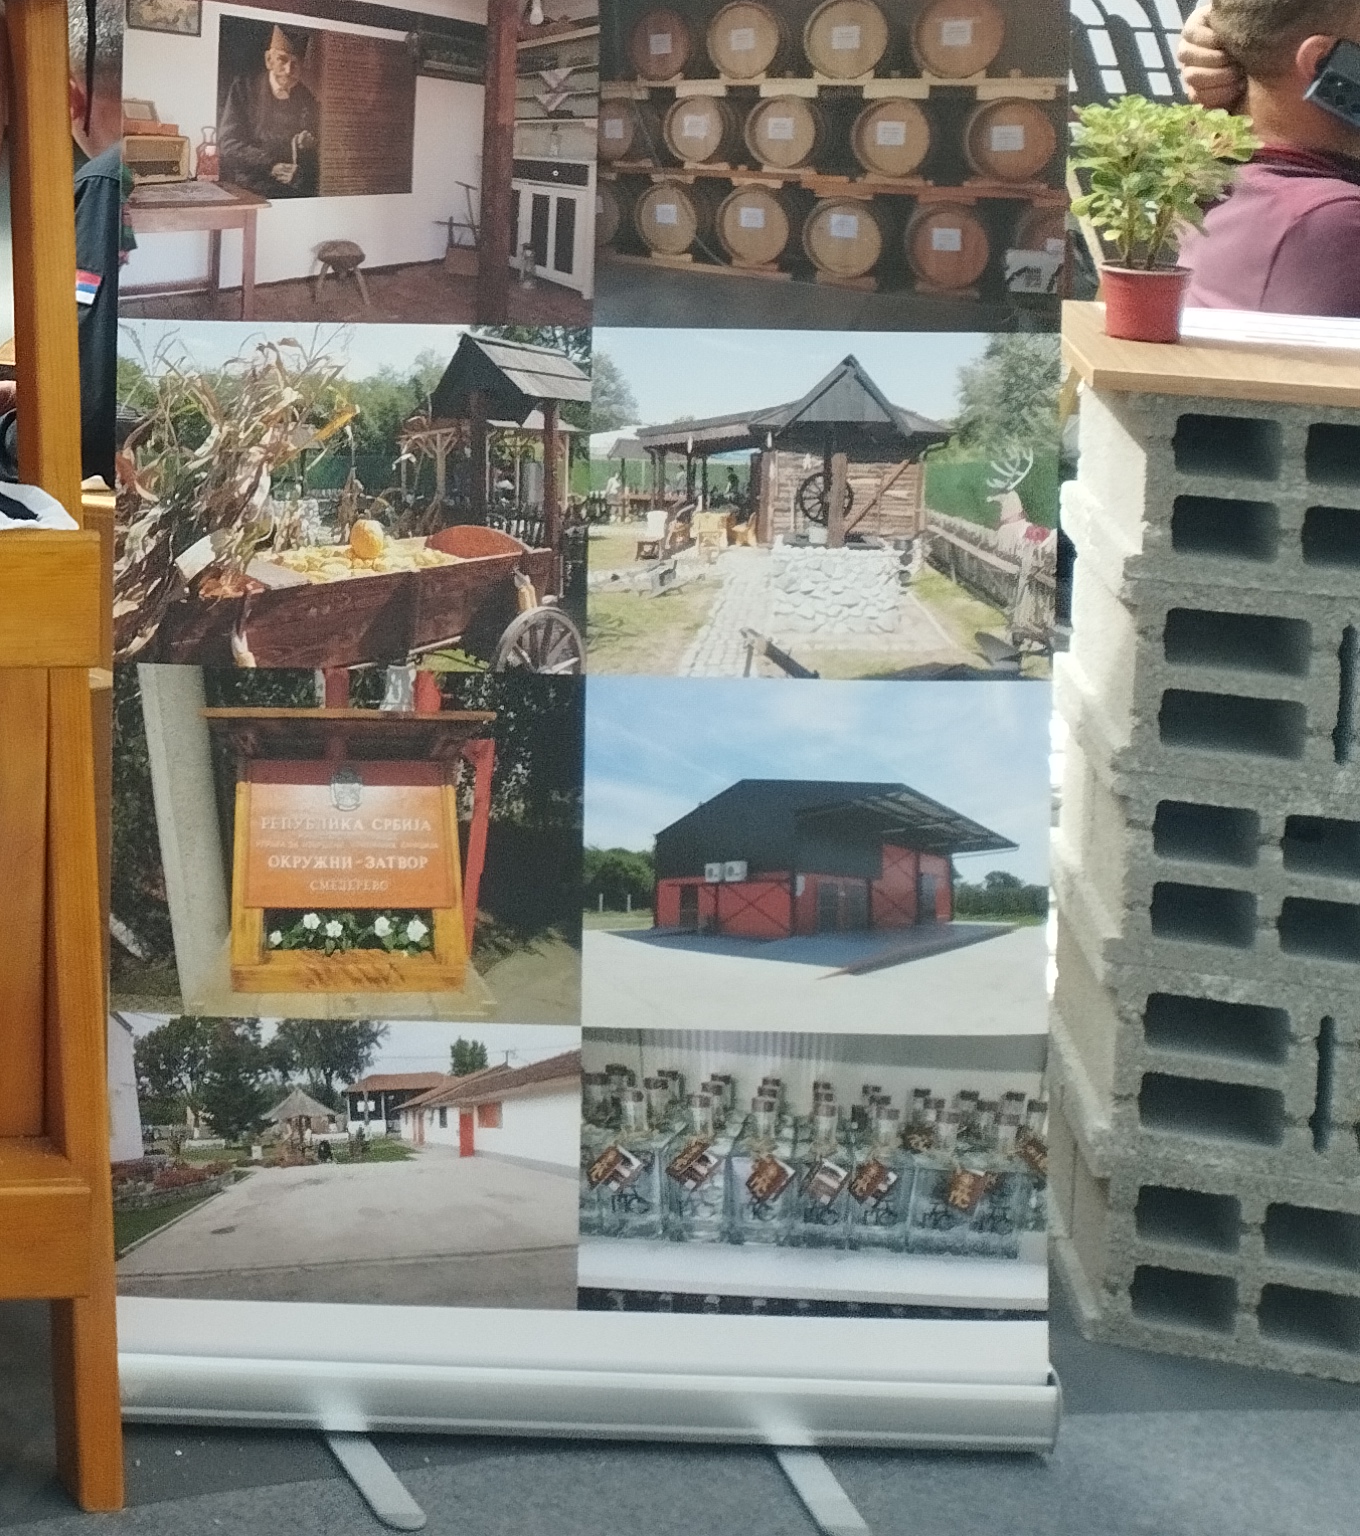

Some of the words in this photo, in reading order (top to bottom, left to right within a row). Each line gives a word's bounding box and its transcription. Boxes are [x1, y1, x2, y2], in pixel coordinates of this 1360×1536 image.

[261, 816, 364, 831] РЕПУБЛИКА
[371, 817, 432, 832] СРБИЈА
[267, 854, 353, 869] ОКРУЖНИ
[364, 855, 429, 870] ЗАТВОР
